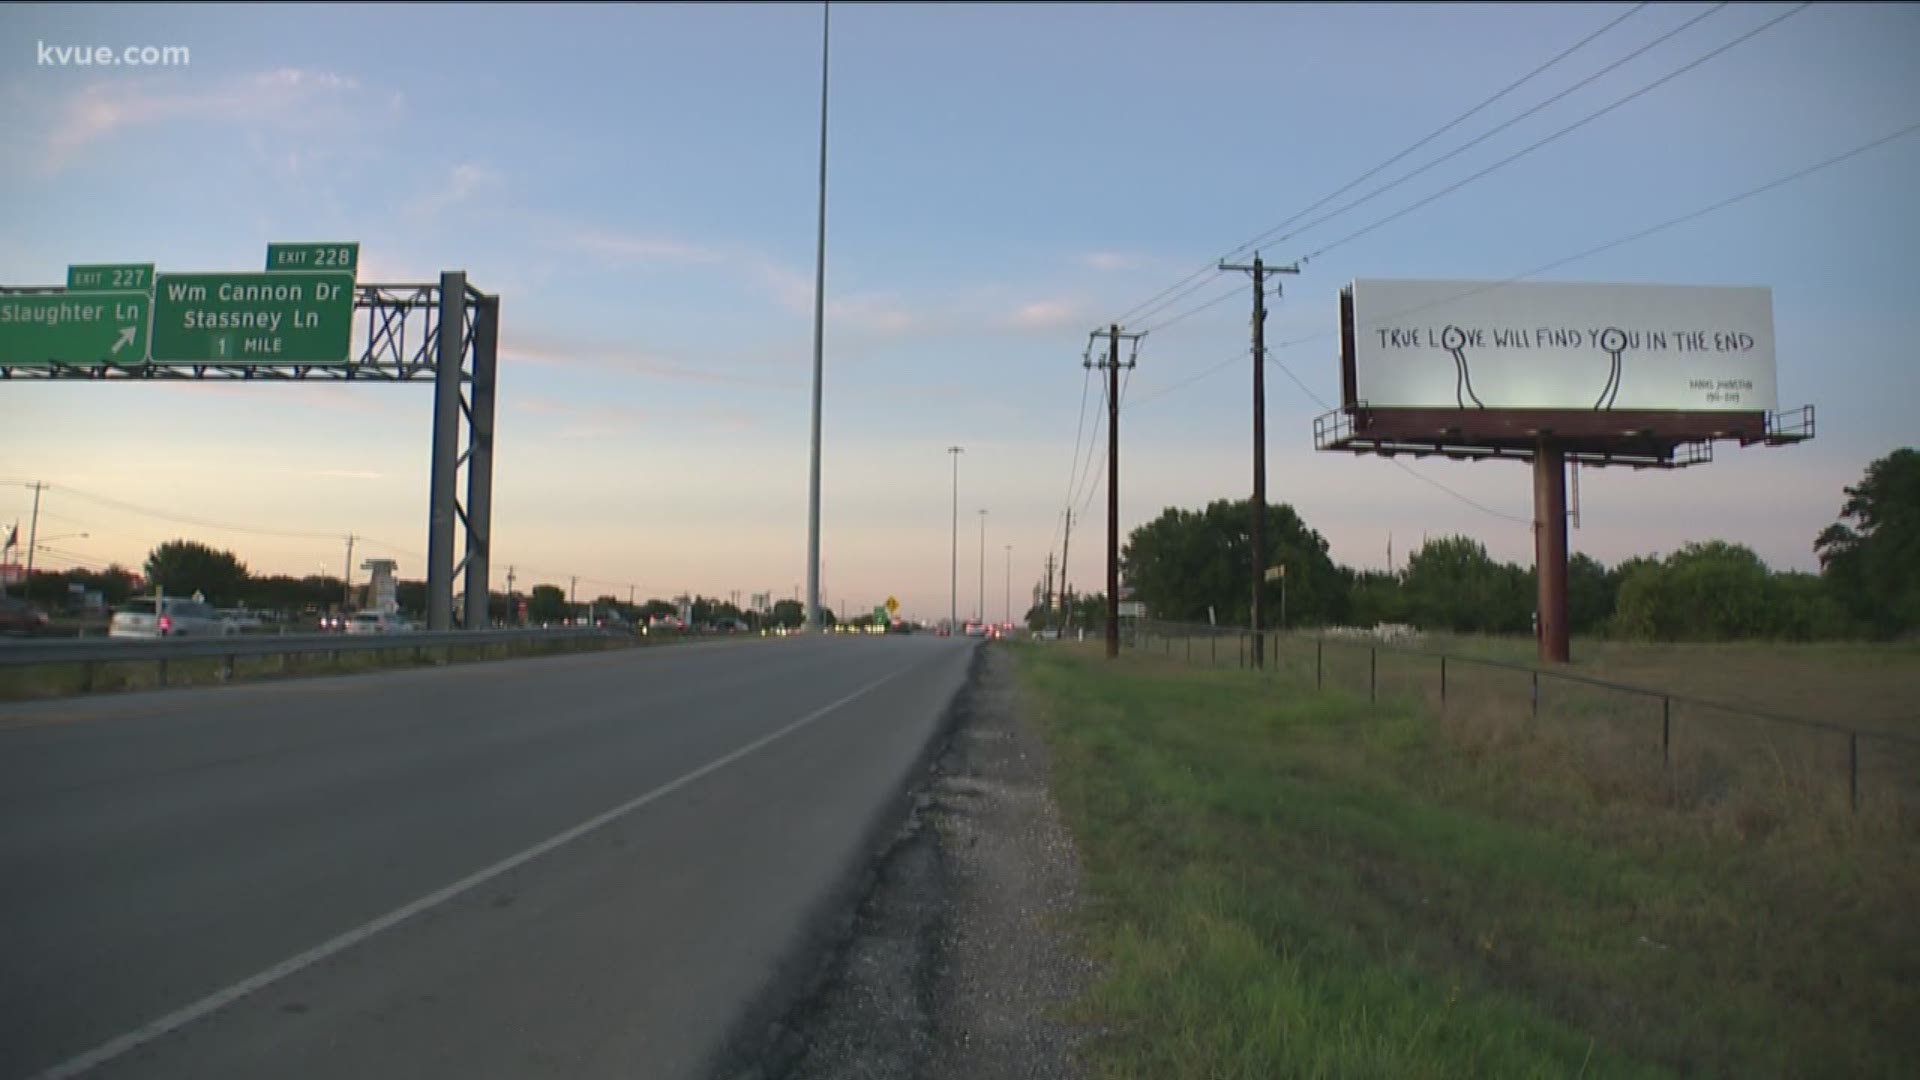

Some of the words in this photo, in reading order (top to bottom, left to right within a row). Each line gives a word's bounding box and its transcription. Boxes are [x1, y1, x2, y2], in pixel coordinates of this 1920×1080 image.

[278, 251, 307, 264] EXIT
[314, 248, 350, 265] 228
[75, 273, 102, 286] EXIT
[112, 269, 144, 287] 227
[168, 284, 207, 301] Wm
[218, 283, 302, 301] Cannon
[316, 283, 342, 301] Dr
[1, 303, 103, 325] Slaughter
[116, 303, 139, 321] Ln
[183, 310, 282, 331] Stassney
[294, 311, 319, 328] Ln
[218, 337, 226, 355] 1
[245, 337, 282, 353] MILE
[1376, 328, 1424, 349] TRUE
[1429, 325, 1487, 350] LOVE
[1494, 328, 1530, 348] WILL
[1537, 327, 1582, 348] FIND
[1588, 326, 1641, 352] YOU
[1647, 331, 1668, 350] IN
[1672, 331, 1710, 352] THE
[1714, 331, 1755, 352] END
